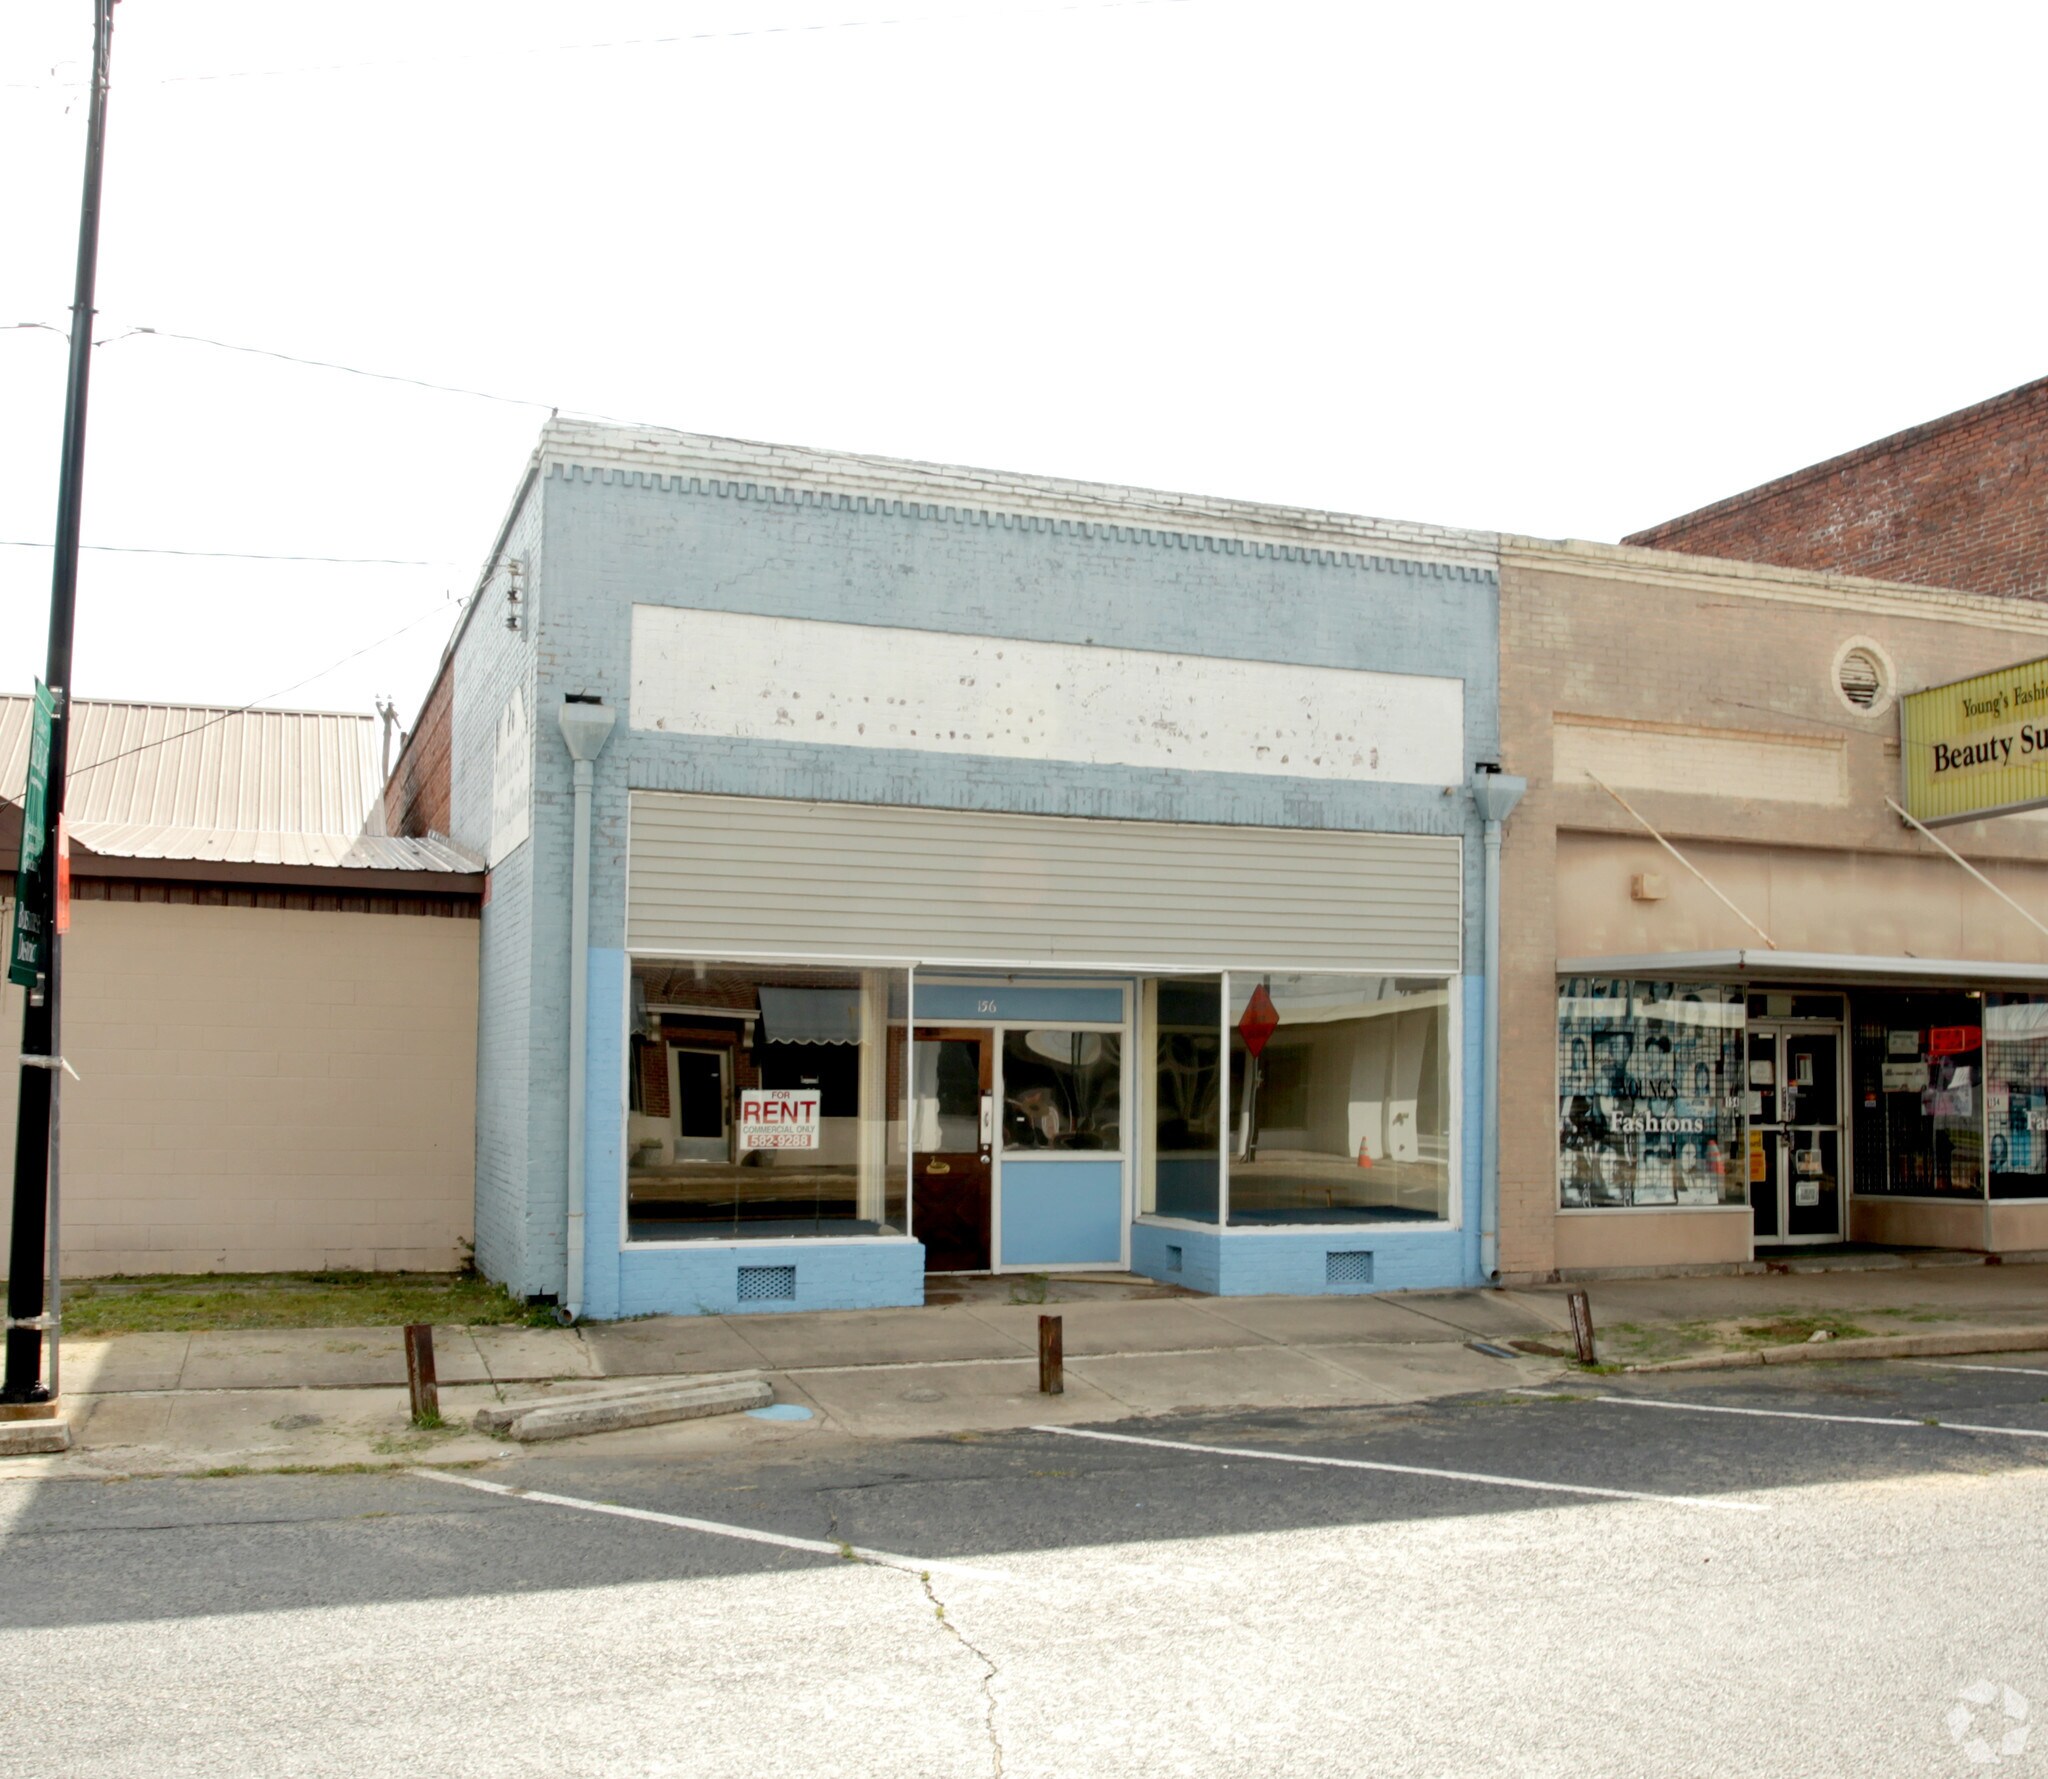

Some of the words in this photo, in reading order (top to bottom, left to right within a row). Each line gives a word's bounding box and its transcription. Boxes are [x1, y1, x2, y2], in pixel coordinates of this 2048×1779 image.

[1963, 691, 2009, 719] Young's
[1934, 735, 2014, 773] Beauty
[2020, 724, 2048, 754] Su
[17, 932, 38, 963] Distric
[977, 999, 997, 1013] 156
[771, 1091, 790, 1099] FOR
[743, 1101, 817, 1124] RENT
[1609, 1110, 1704, 1134] Fashions
[2026, 1110, 2048, 1131] Fa
[743, 1125, 794, 1134] COMMERCIAL
[796, 1125, 816, 1134] ONLY
[751, 1135, 808, 1147] 582-9288
